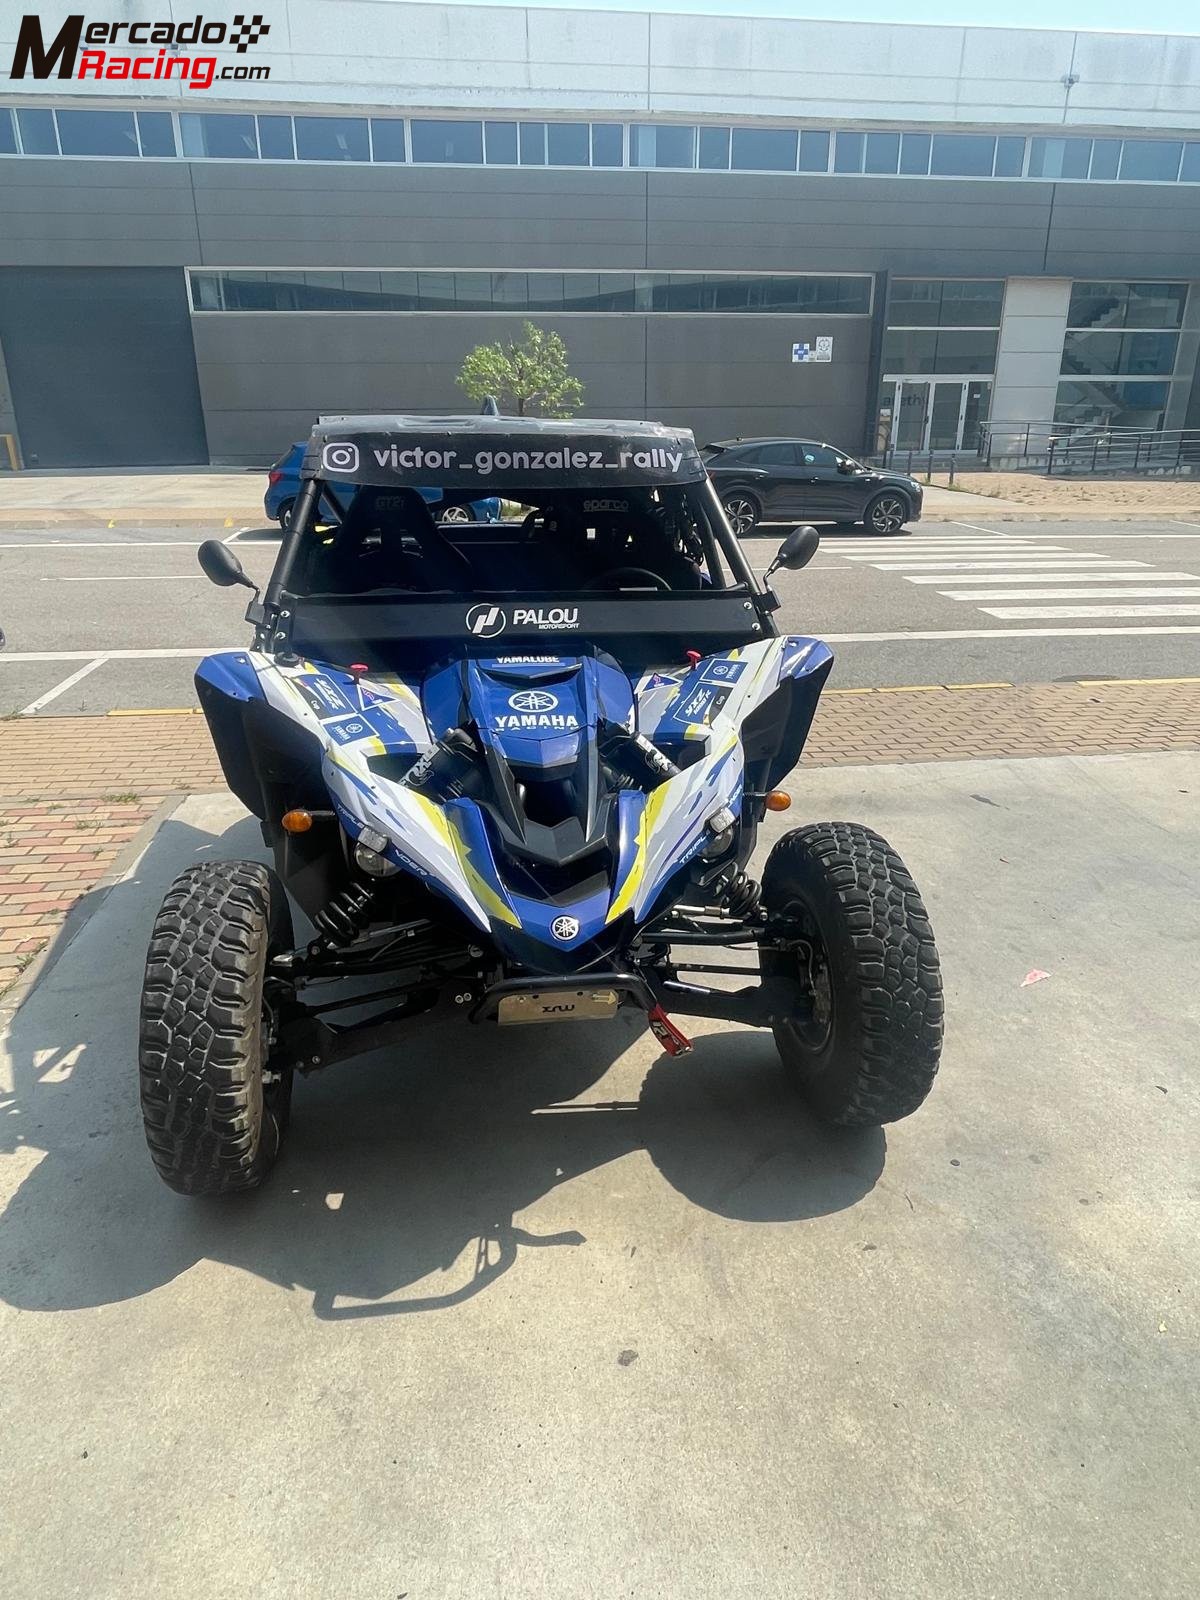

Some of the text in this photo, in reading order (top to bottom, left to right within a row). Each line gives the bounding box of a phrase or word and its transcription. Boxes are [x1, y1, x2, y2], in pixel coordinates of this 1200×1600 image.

[512, 607, 579, 625] PALOU
[538, 622, 580, 630] MOTORSPORT
[496, 655, 560, 664] YAMALUBE
[494, 714, 580, 728] YAMAHA
